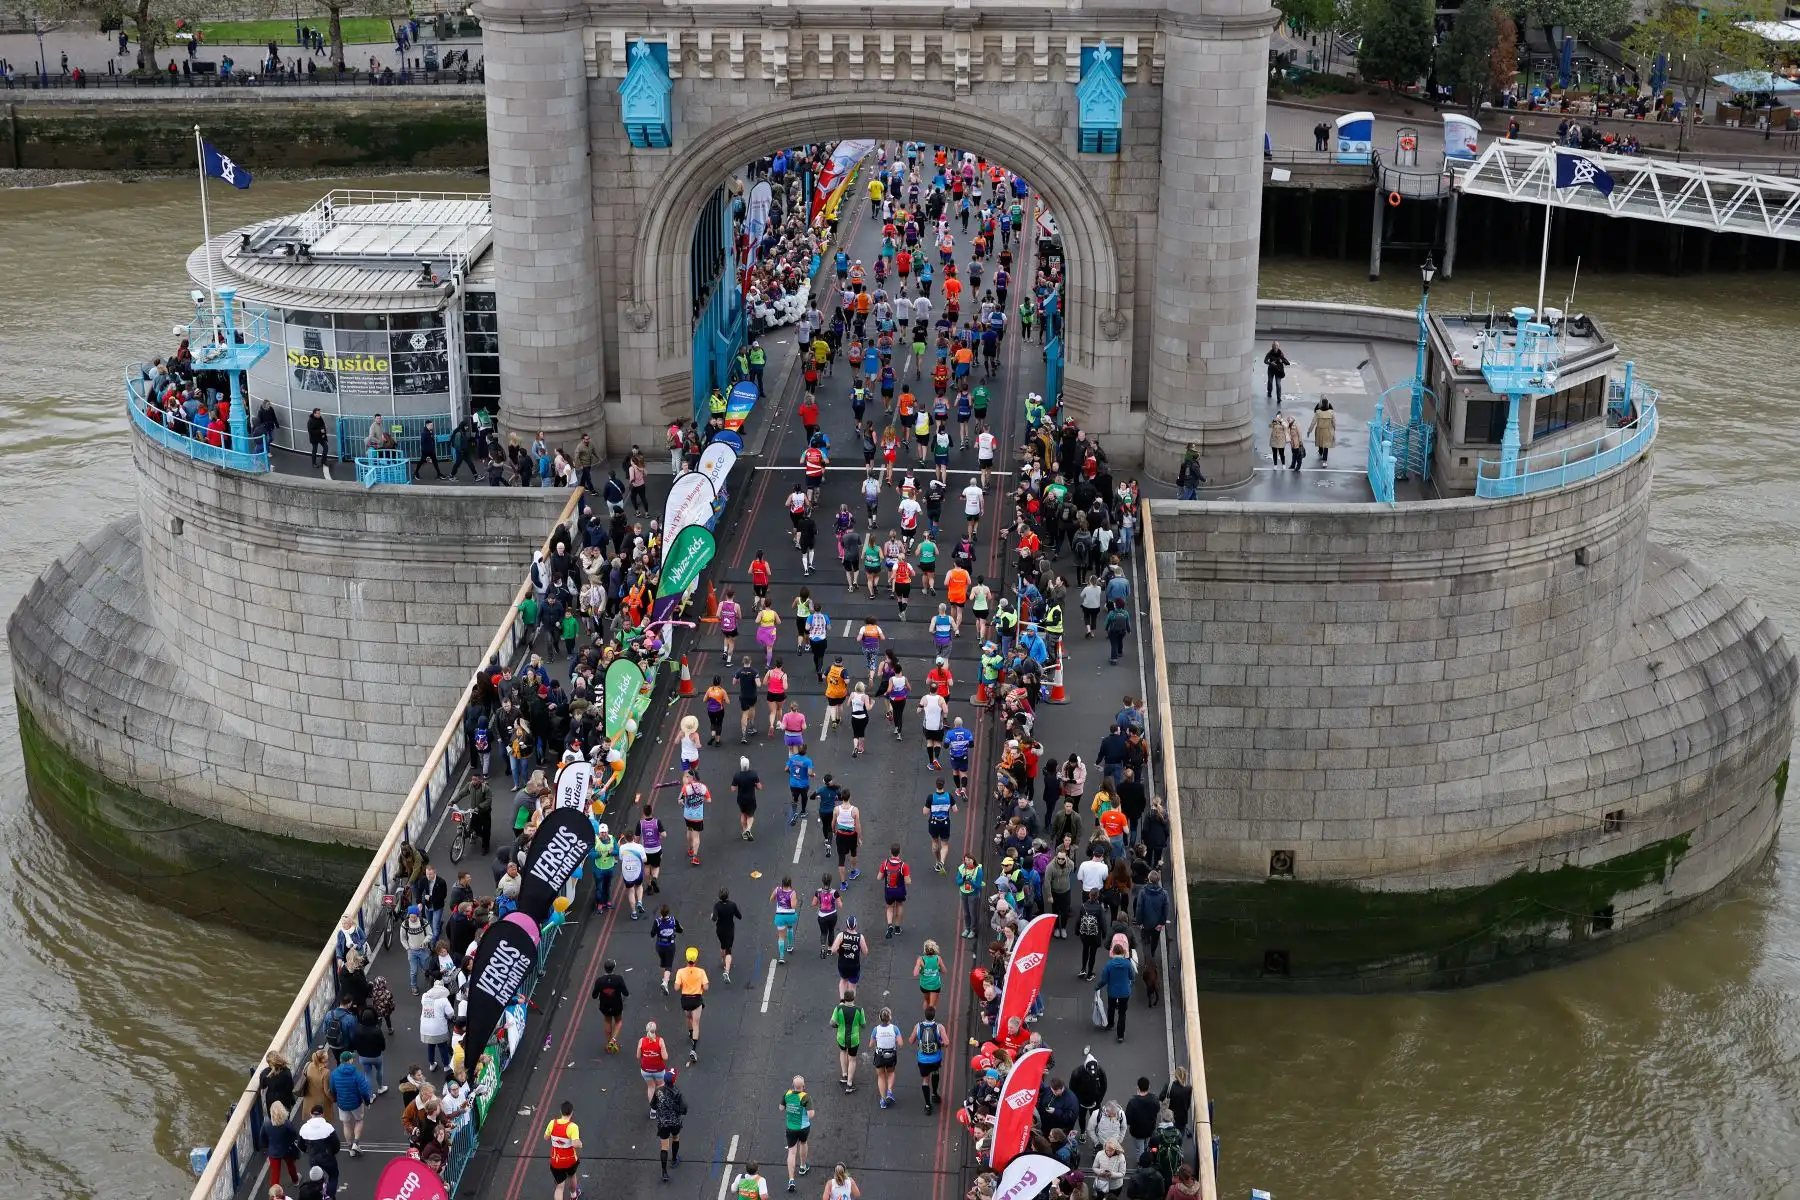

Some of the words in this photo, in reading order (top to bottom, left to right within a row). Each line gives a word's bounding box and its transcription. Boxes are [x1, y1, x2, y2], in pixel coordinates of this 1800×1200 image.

[288, 349, 320, 368] See
[323, 352, 389, 372] inside
[664, 523, 676, 544] Royal
[687, 479, 706, 502] Hospice
[530, 825, 578, 882] VERSUS
[548, 840, 588, 892] ARTHRITIS
[843, 934, 860, 942] MATT
[1023, 953, 1041, 970] aid
[476, 940, 521, 997] VERSUS
[495, 954, 531, 1006] ARTHRITIS
[1015, 1090, 1033, 1107] aid
